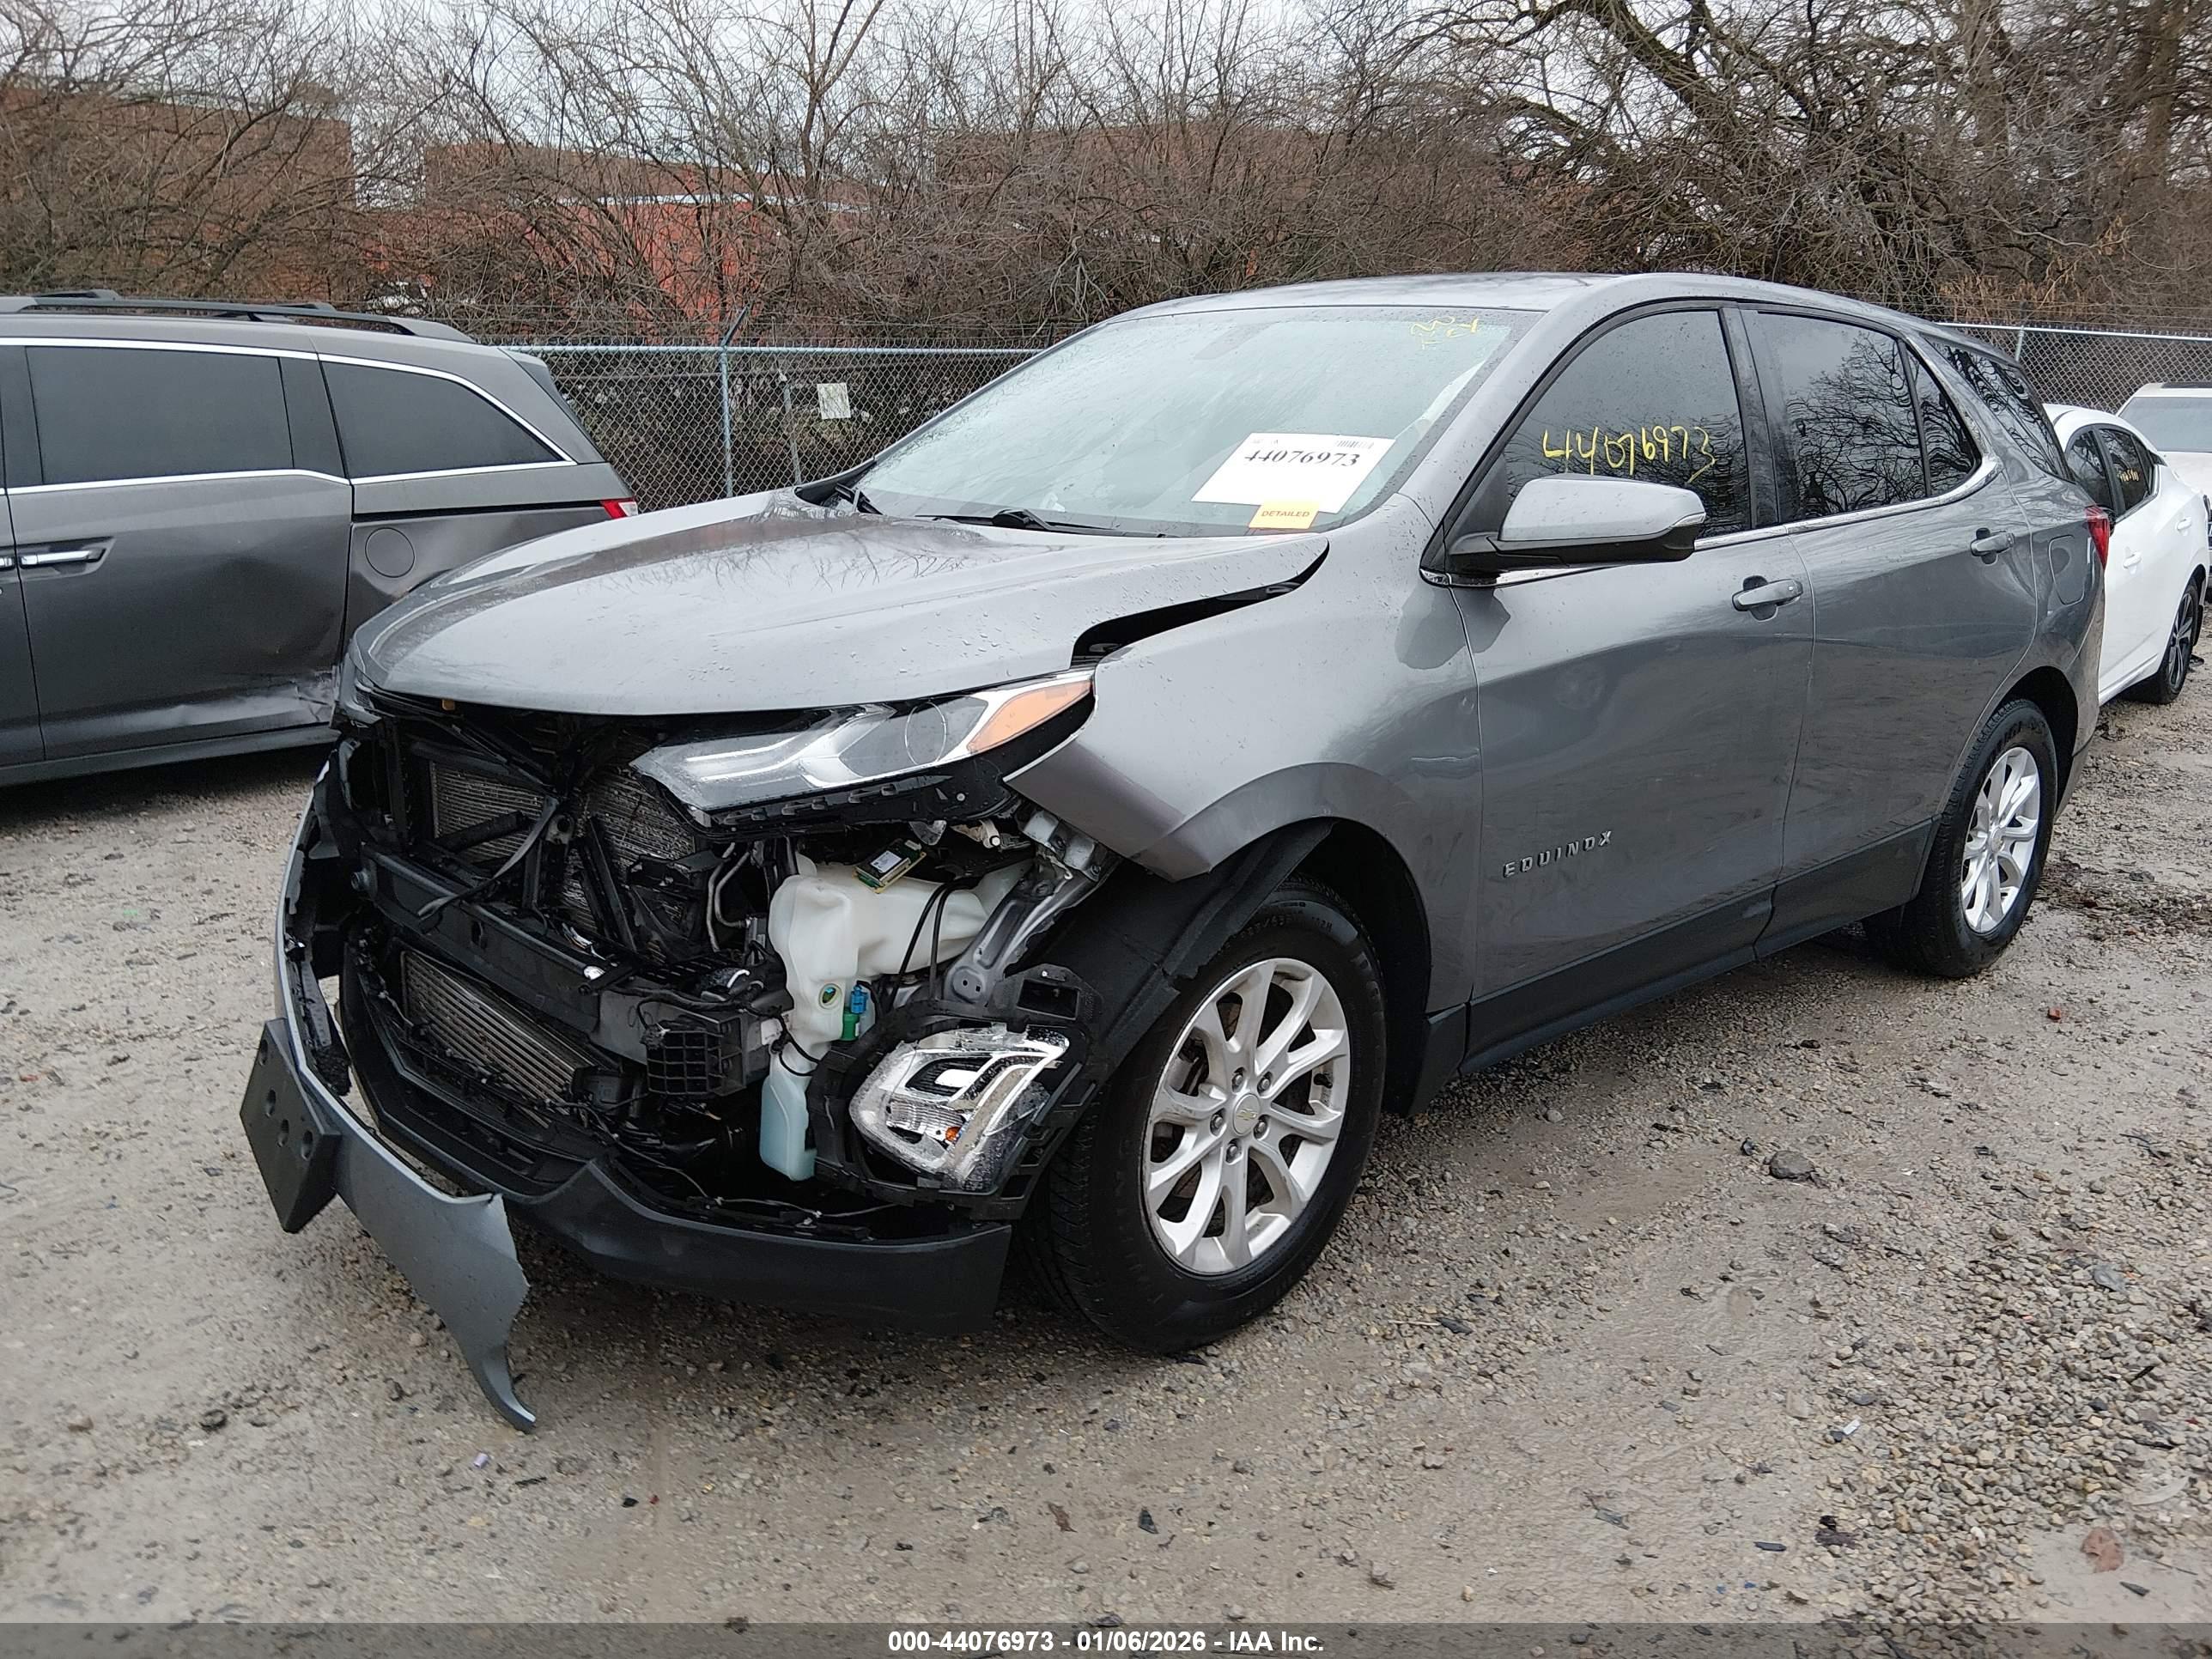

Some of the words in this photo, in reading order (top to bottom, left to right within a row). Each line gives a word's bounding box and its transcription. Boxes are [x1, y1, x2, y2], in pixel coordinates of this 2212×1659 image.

[1244, 449, 1360, 467] 44076973
[1542, 426, 1718, 483] 44076973
[1503, 830, 1612, 878] EQUINOX
